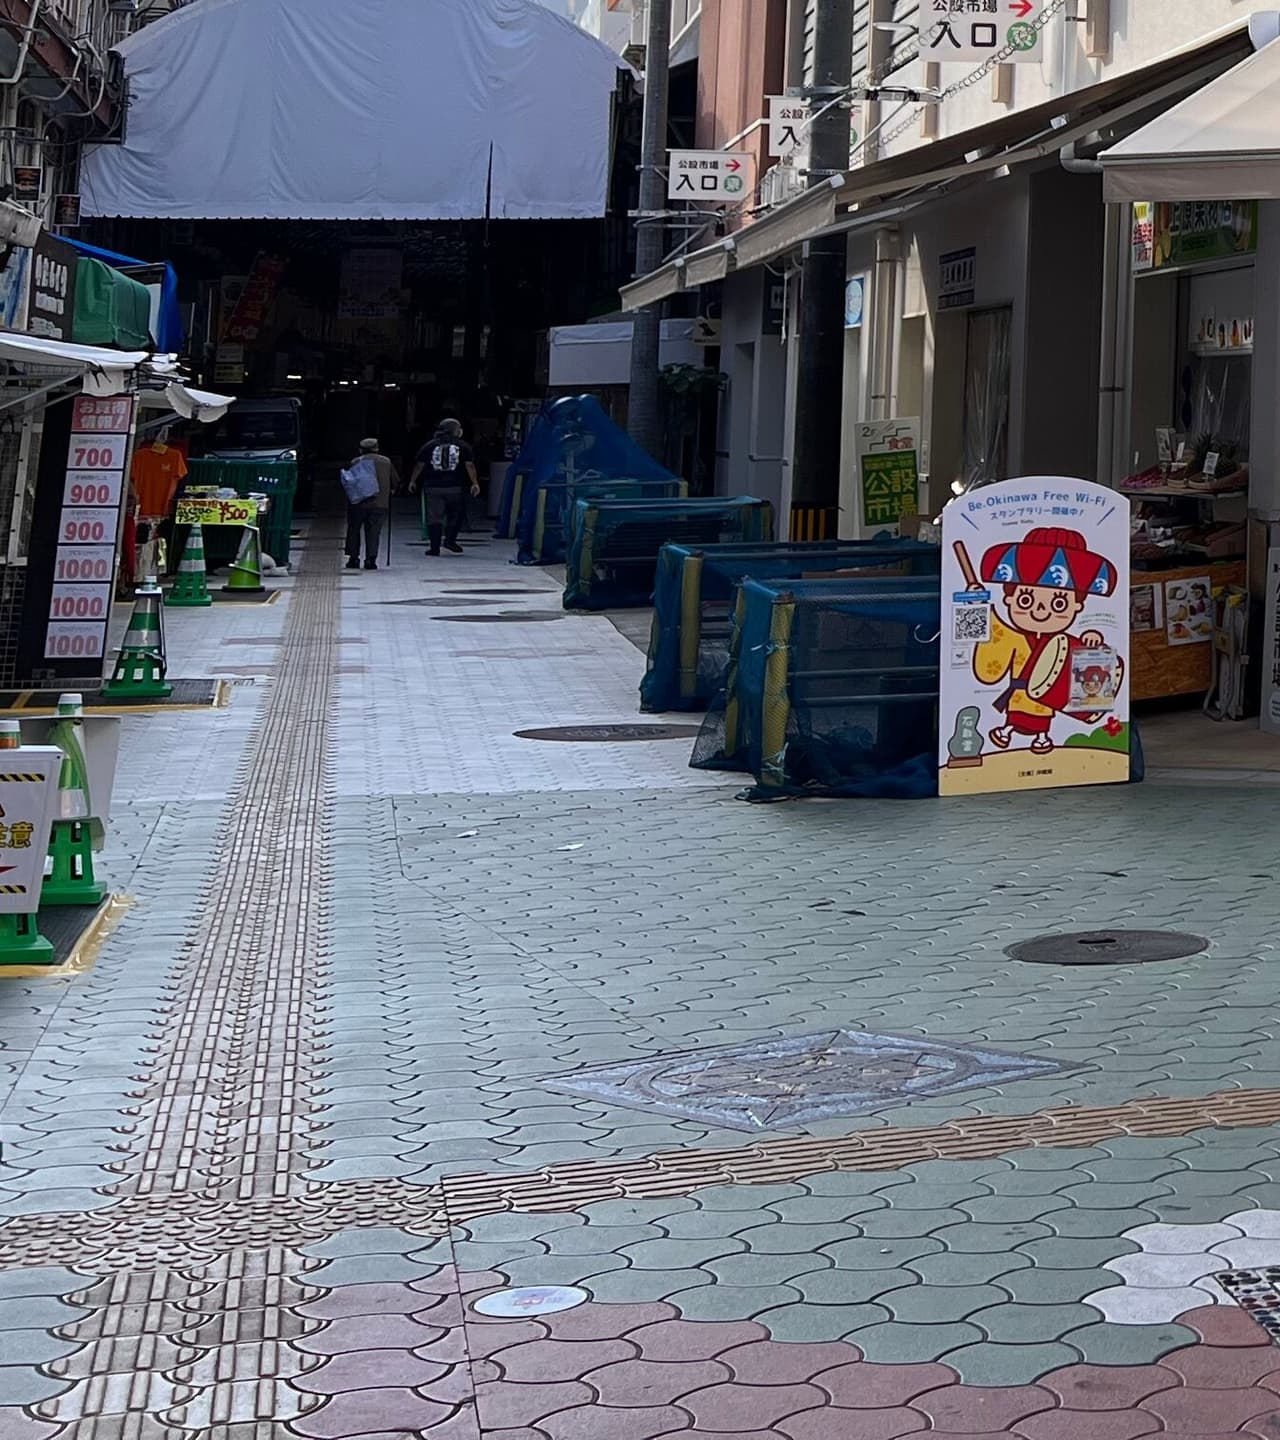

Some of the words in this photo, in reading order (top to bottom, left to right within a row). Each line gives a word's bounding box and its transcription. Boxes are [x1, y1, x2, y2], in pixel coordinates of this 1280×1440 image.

[930, 21, 997, 48] 入口
[779, 126, 802, 146] 入
[678, 160, 719, 170] 公設市場
[676, 174, 718, 191] 入口
[74, 448, 112, 467] 700
[865, 469, 917, 495] 公設
[70, 484, 109, 504] 900
[968, 493, 1038, 511] Be.Okinawa
[1043, 491, 1070, 502] Free
[1075, 492, 1106, 507] Wi-Fi
[64, 521, 104, 541] 900
[58, 559, 107, 579] 1000
[53, 596, 102, 617] 1000
[48, 635, 98, 655] 1000
